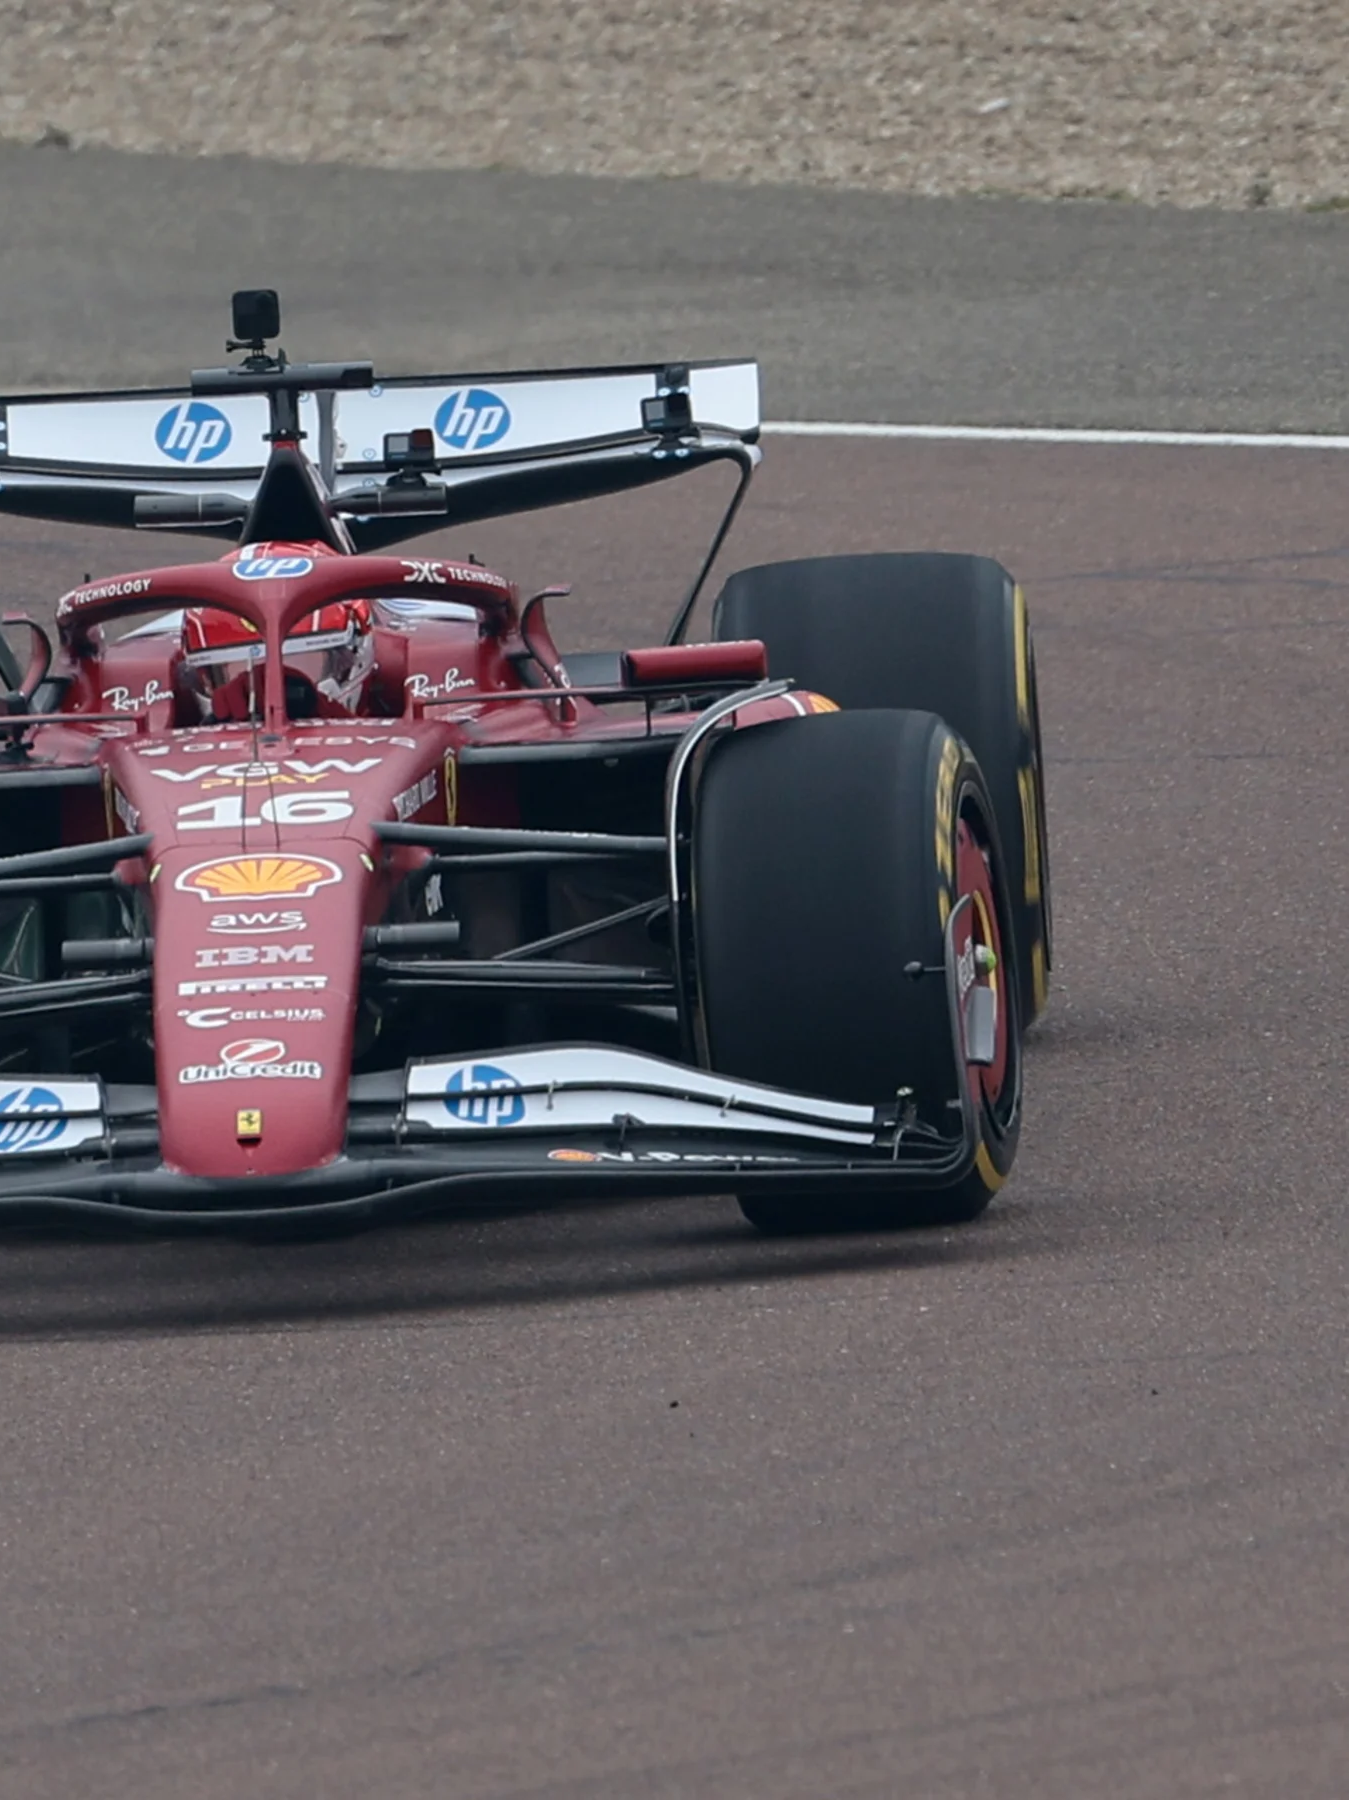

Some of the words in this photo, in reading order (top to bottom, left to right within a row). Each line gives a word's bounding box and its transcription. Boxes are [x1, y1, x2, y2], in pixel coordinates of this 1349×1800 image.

[438, 388, 506, 450] hp
[161, 402, 227, 464] hp
[74, 577, 151, 605] TECHNOLOGY
[150, 757, 383, 783] VGW
[200, 772, 330, 790] PLAY
[176, 790, 355, 830] 16
[210, 910, 304, 928] aws
[194, 944, 315, 968] IBM
[177, 975, 329, 997] PIRELLI
[230, 1008, 323, 1021] CELSIUS
[181, 1063, 319, 1083] UniCredit
